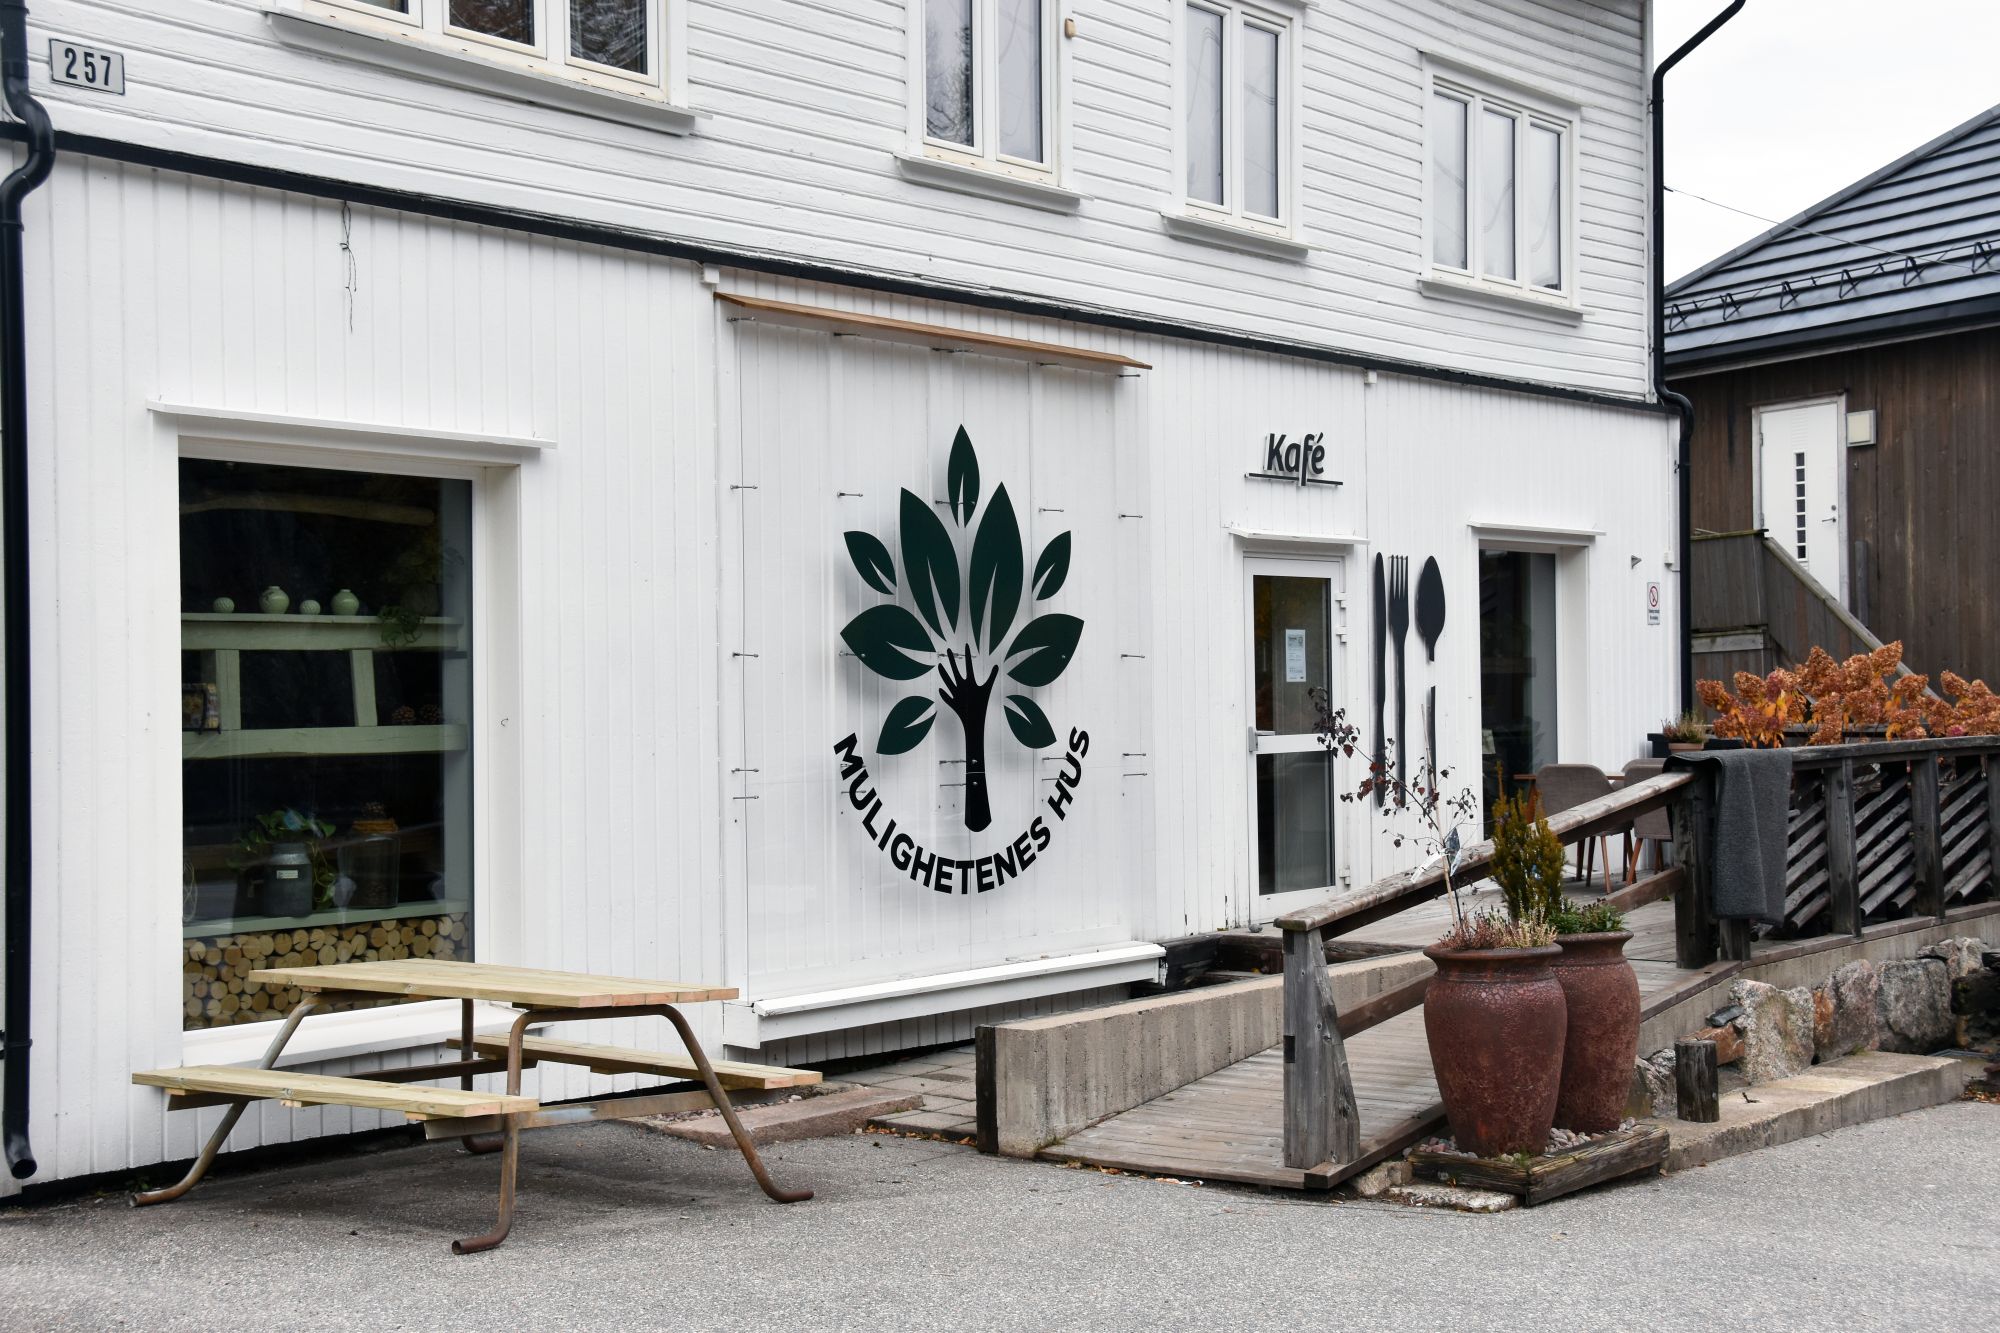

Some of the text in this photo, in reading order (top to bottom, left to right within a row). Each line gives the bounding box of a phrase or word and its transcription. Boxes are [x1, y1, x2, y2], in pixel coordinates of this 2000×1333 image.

[65, 48, 111, 86] 257
[1266, 432, 1325, 486] Kafé
[833, 726, 1090, 894] MULIGHETENES HUS
